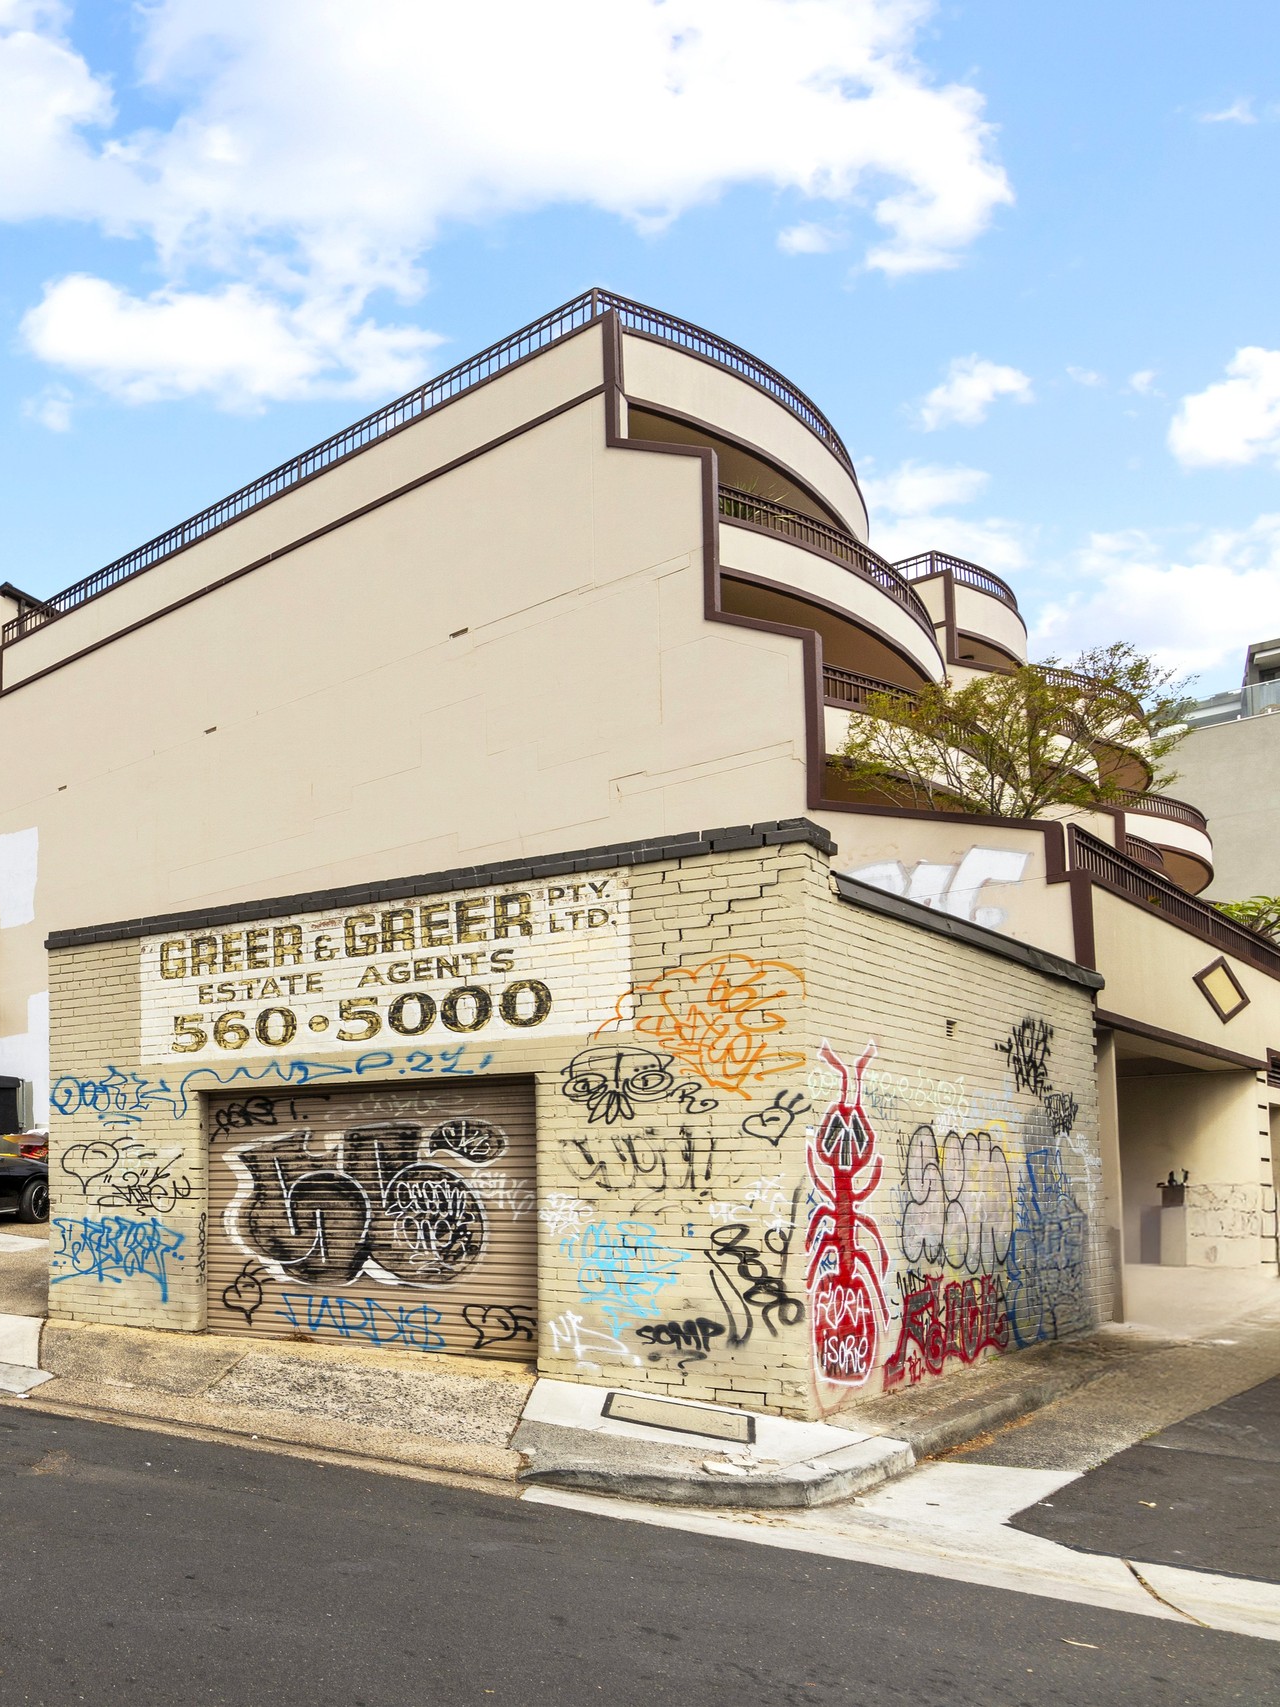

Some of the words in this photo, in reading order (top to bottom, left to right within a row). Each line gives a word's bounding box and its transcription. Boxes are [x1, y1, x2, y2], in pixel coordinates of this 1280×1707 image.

[160, 924, 304, 980] GREER
[314, 934, 341, 962] &
[344, 892, 533, 958] GREER
[548, 880, 611, 907] PTY.
[549, 908, 618, 933] LTD.
[198, 972, 324, 1005] ESTATE
[357, 949, 515, 988] AGENTS
